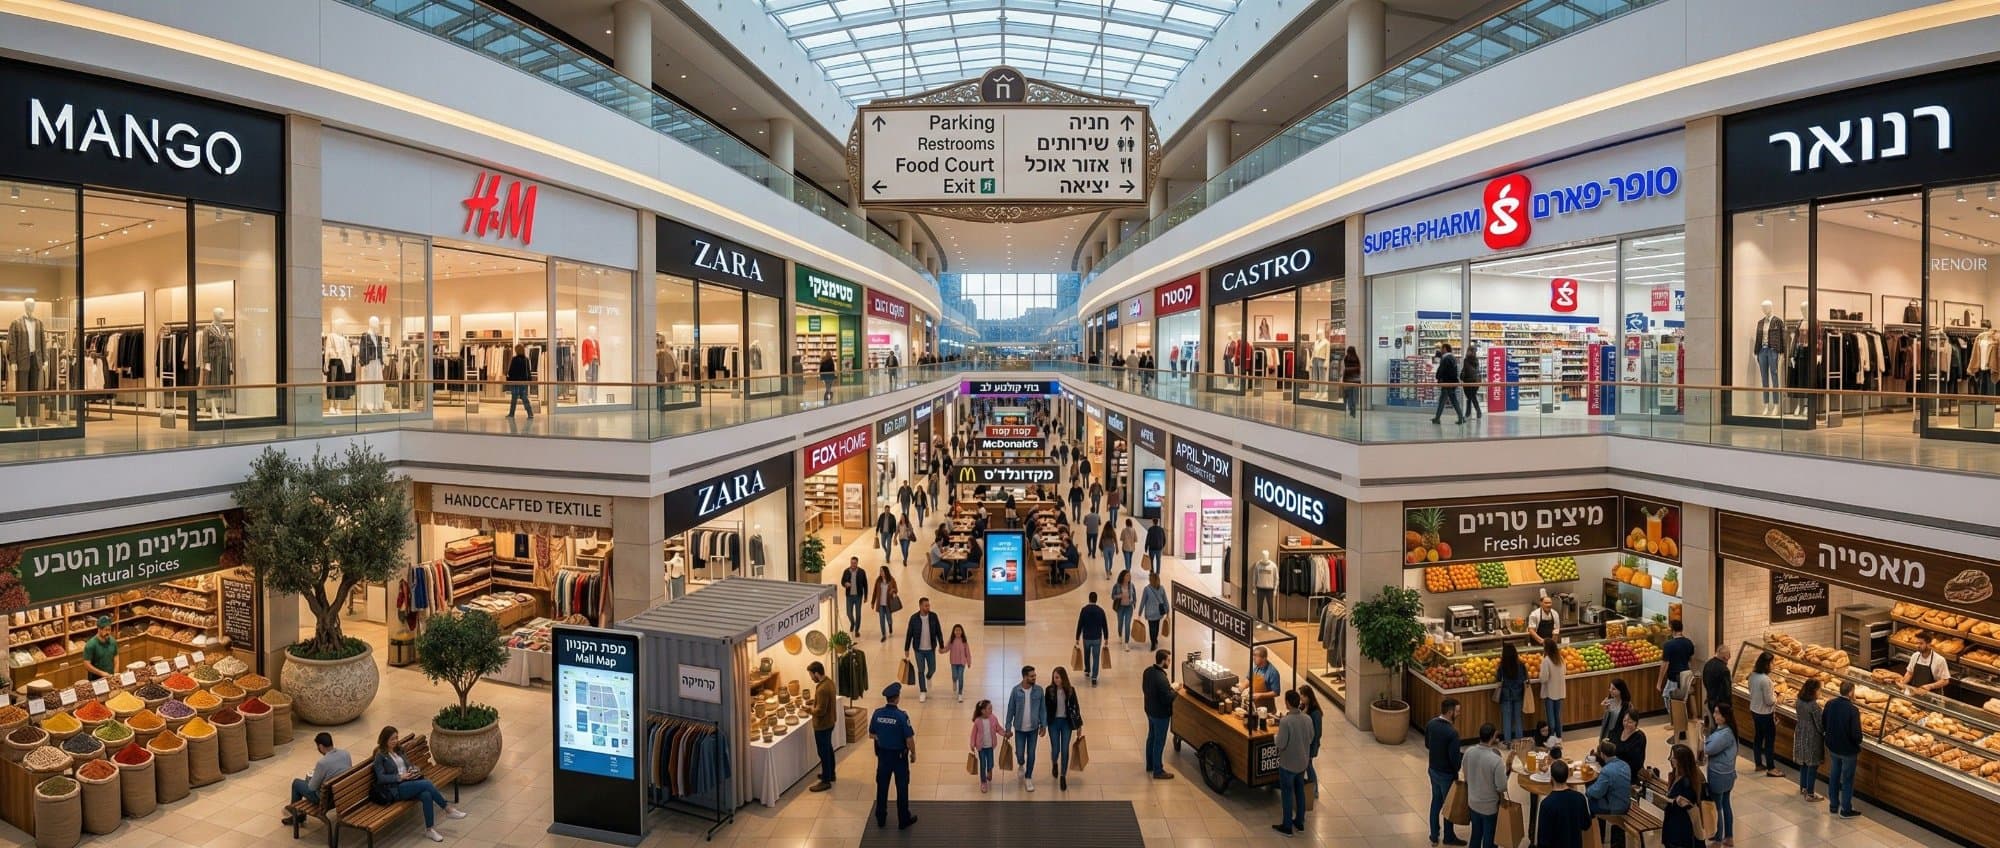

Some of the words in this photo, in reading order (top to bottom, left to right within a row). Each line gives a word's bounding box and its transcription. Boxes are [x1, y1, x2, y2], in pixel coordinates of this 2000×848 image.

[930, 115, 995, 133] Parking
[1069, 116, 1110, 131] חניה
[31, 98, 242, 175] MANGO
[918, 138, 995, 151] Restrooms
[1037, 137, 1110, 151] שירותים
[1769, 105, 1951, 172] רנואר
[896, 157, 939, 172] Food
[945, 157, 995, 172] Court
[1025, 155, 1066, 172] אוכל
[1072, 158, 1110, 172] אזור
[944, 178, 976, 194] Exit
[1060, 179, 1110, 194] יציאה
[1533, 166, 1679, 220] סופר-פארם
[462, 171, 538, 245] H&M
[1363, 209, 1481, 255] SUPER-PHARM
[694, 239, 764, 282] ZARA
[1222, 248, 1311, 291] CASTRO
[1931, 257, 1988, 272] RENOIR
[363, 283, 388, 304] H&M
[808, 275, 853, 303] סטימצקי
[1161, 284, 1193, 308] קסטרו
[812, 442, 837, 469] FOX
[839, 432, 867, 457] HOME
[982, 439, 1039, 449] McDonald's
[1175, 441, 1200, 466] APRIL
[1202, 449, 1229, 477] אפריל
[698, 469, 767, 516] ZARA
[1254, 475, 1324, 525] HOODIES
[444, 493, 543, 513] HANDCCAFTED
[546, 501, 602, 517] TEXTILE
[1536, 505, 1604, 529] מיצים
[1459, 511, 1528, 534] טריים
[139, 527, 217, 557] תבלינים
[1484, 535, 1528, 552] Fresh
[1533, 532, 1580, 549] Juices
[33, 547, 100, 577] הטבע
[107, 542, 130, 568] מן
[1818, 543, 1926, 588] מאפייה
[82, 563, 134, 588] Natural
[138, 558, 180, 577] Spices
[1175, 592, 1210, 619] ARTISAN
[1786, 602, 1816, 615] Bakery
[778, 604, 815, 632] POTTERY
[600, 643, 627, 655] מפת
[596, 655, 617, 669] Map
[682, 675, 716, 691] קרמיקה
